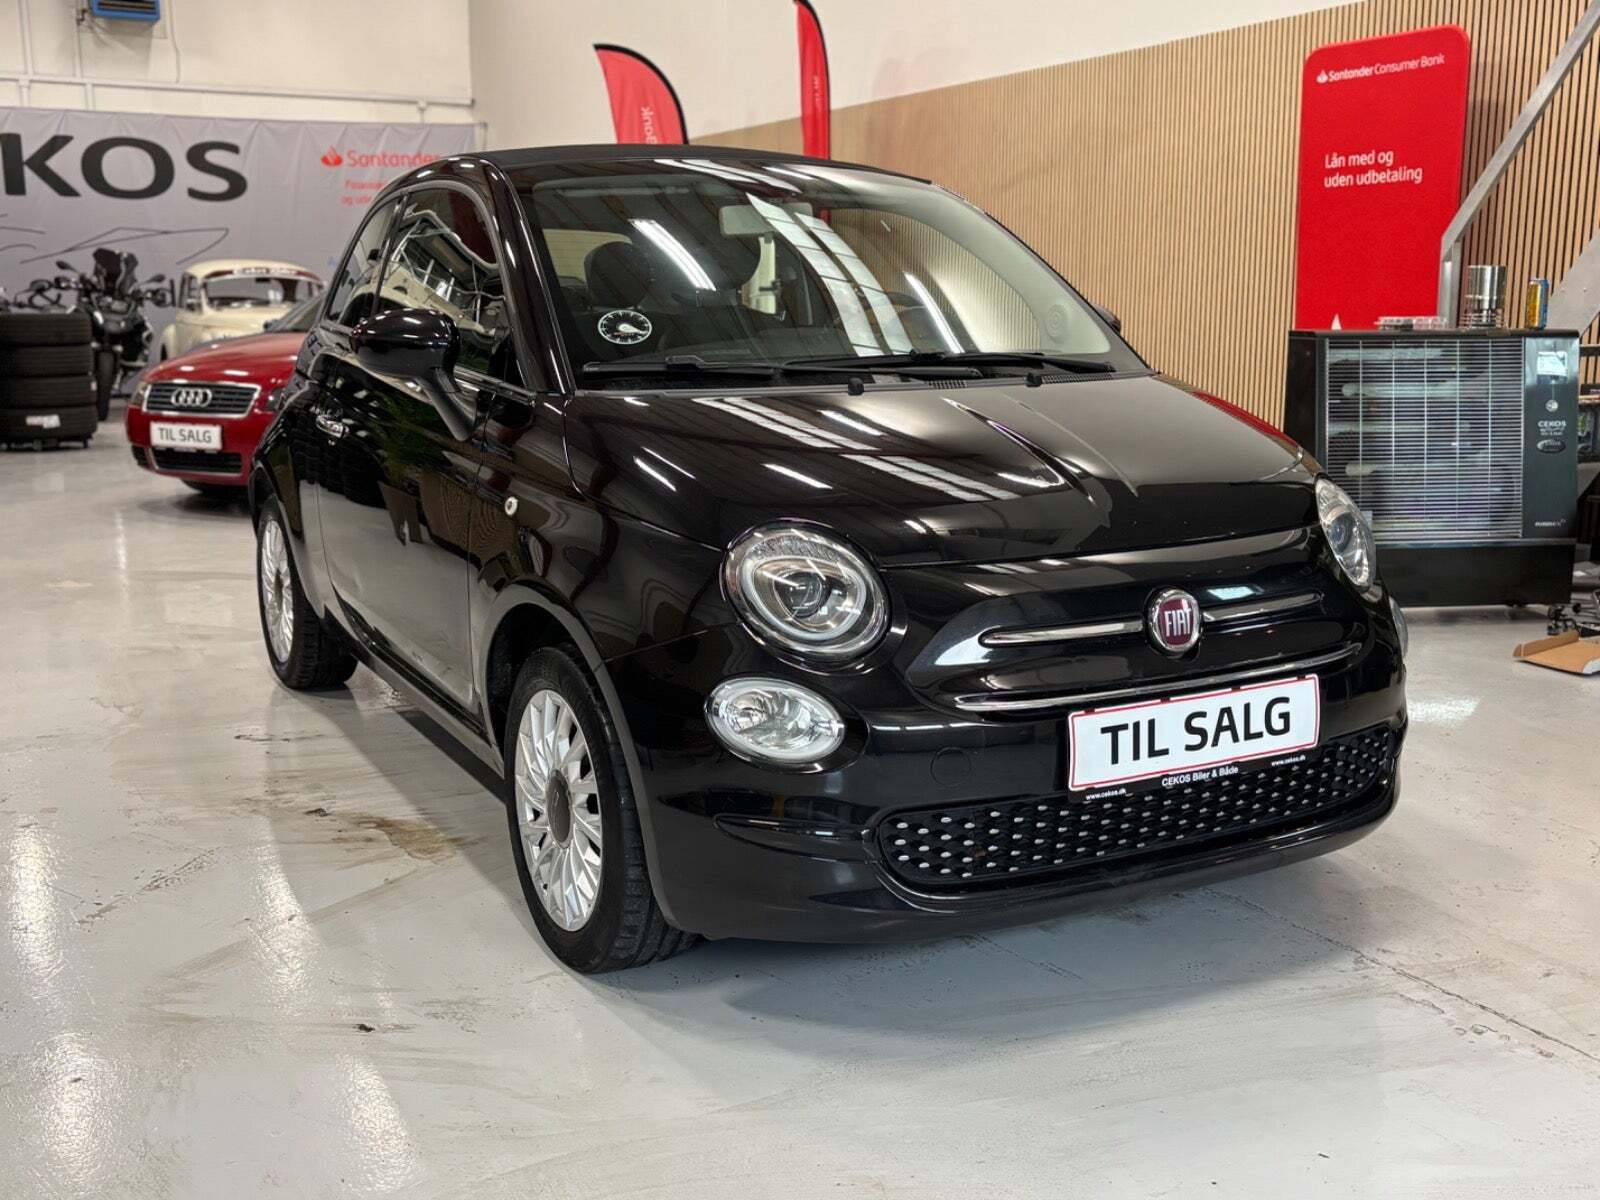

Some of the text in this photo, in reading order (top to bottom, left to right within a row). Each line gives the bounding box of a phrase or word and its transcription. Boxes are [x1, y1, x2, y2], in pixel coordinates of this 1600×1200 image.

[1328, 53, 1445, 82] Santander Consumer Bank
[1324, 149, 1394, 169] Lån med og
[1324, 165, 1423, 188] uden udbetaling
[158, 427, 212, 444] TIL SALG
[1164, 608, 1191, 637] FIAT
[1100, 696, 1291, 766] TIL SALG
[1085, 753, 1306, 801] www.cekos.dk CEKOS Biler & Både www.cekos.dk
